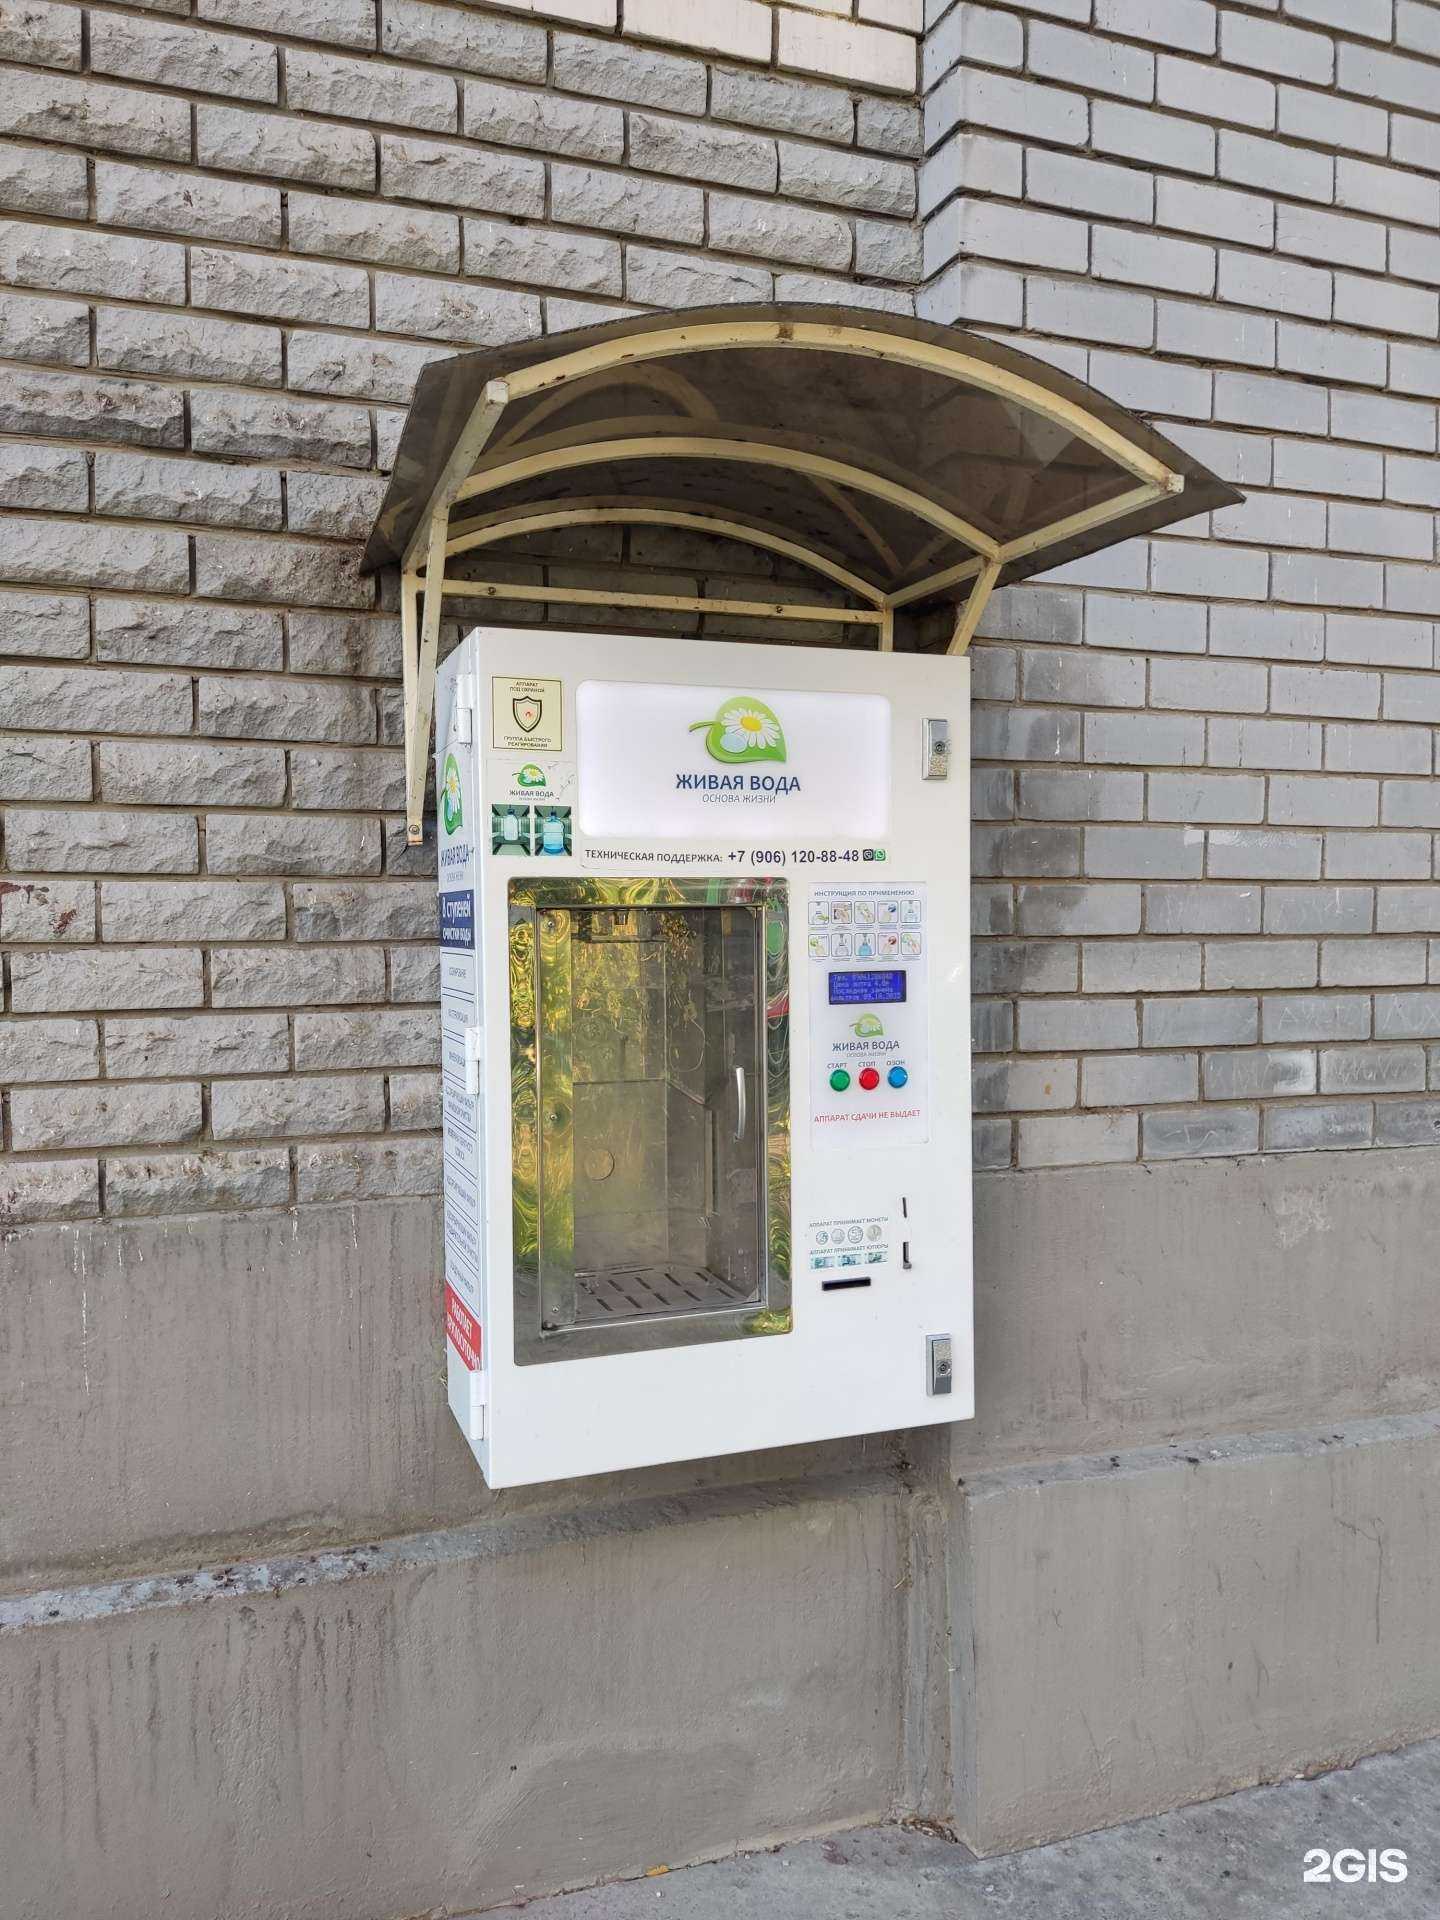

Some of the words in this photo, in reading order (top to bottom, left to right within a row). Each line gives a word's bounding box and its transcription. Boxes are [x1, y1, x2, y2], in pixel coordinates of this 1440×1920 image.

[675, 773, 744, 790] ЖИВАЯ
[749, 775, 801, 796] ВОДА
[510, 789, 534, 797] ЖИВАЯ
[535, 790, 554, 798] ВОДА
[702, 793, 741, 803] ОСНОВА
[742, 794, 776, 804] ЖИЗНИ
[585, 849, 654, 862] ТЕХНИЧЕСКАЯ
[656, 852, 723, 864] ПОДДЕРЖКА:
[728, 850, 746, 862] +7
[750, 850, 786, 866] (906)
[791, 850, 860, 864] 120-88-48
[814, 889, 857, 897] ИНСТРУКЦИЯ
[869, 889, 915, 897] ПРИМЕНЕНИЮ
[832, 1041, 869, 1052] ЖИВАЯ
[872, 1040, 900, 1052] ВОДА
[814, 1114, 849, 1123] АППАРАТ
[851, 1112, 877, 1121] СДАЧИ
[878, 1111, 889, 1119] НЕ
[890, 1109, 921, 1118] ВЫДАЕТ
